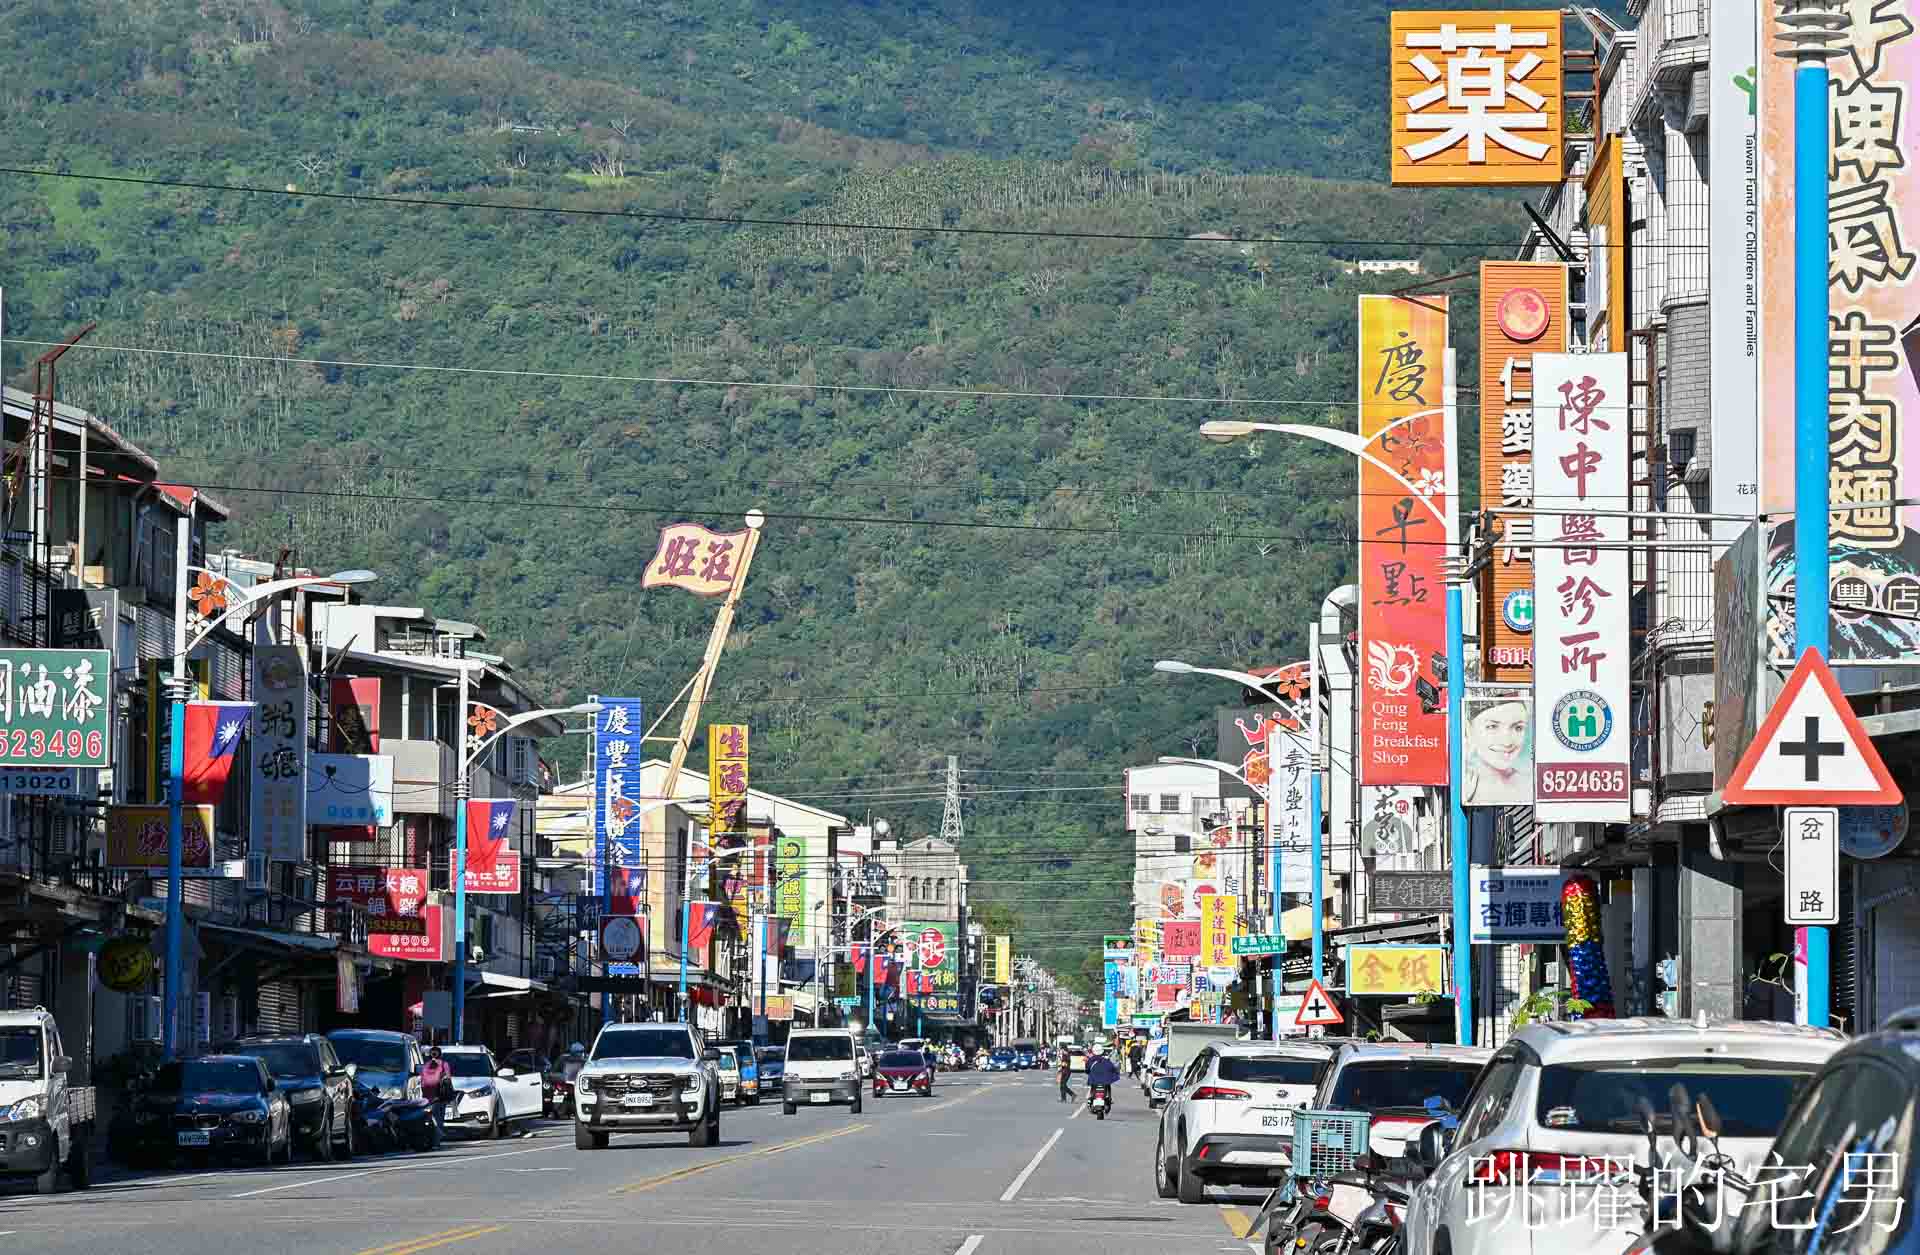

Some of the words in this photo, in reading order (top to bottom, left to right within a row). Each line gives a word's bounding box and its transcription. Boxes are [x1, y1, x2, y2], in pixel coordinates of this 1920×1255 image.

[1746, 134, 1756, 174] Taiwan
[1746, 178, 1757, 206] Fund
[1746, 211, 1757, 228] for
[1746, 232, 1757, 280] Children
[1746, 284, 1756, 305] and
[1746, 310, 1757, 357] Families
[1552, 375, 1613, 683] 陳中醫診所
[1784, 583, 1919, 614] 豐店
[1372, 700, 1408, 717] Qing
[1373, 719, 1408, 733] Feng
[1373, 735, 1439, 748] Breakfast
[1373, 751, 1409, 765] Shop
[1543, 770, 1624, 793] 8524635
[1800, 817, 1824, 913] 岔路
